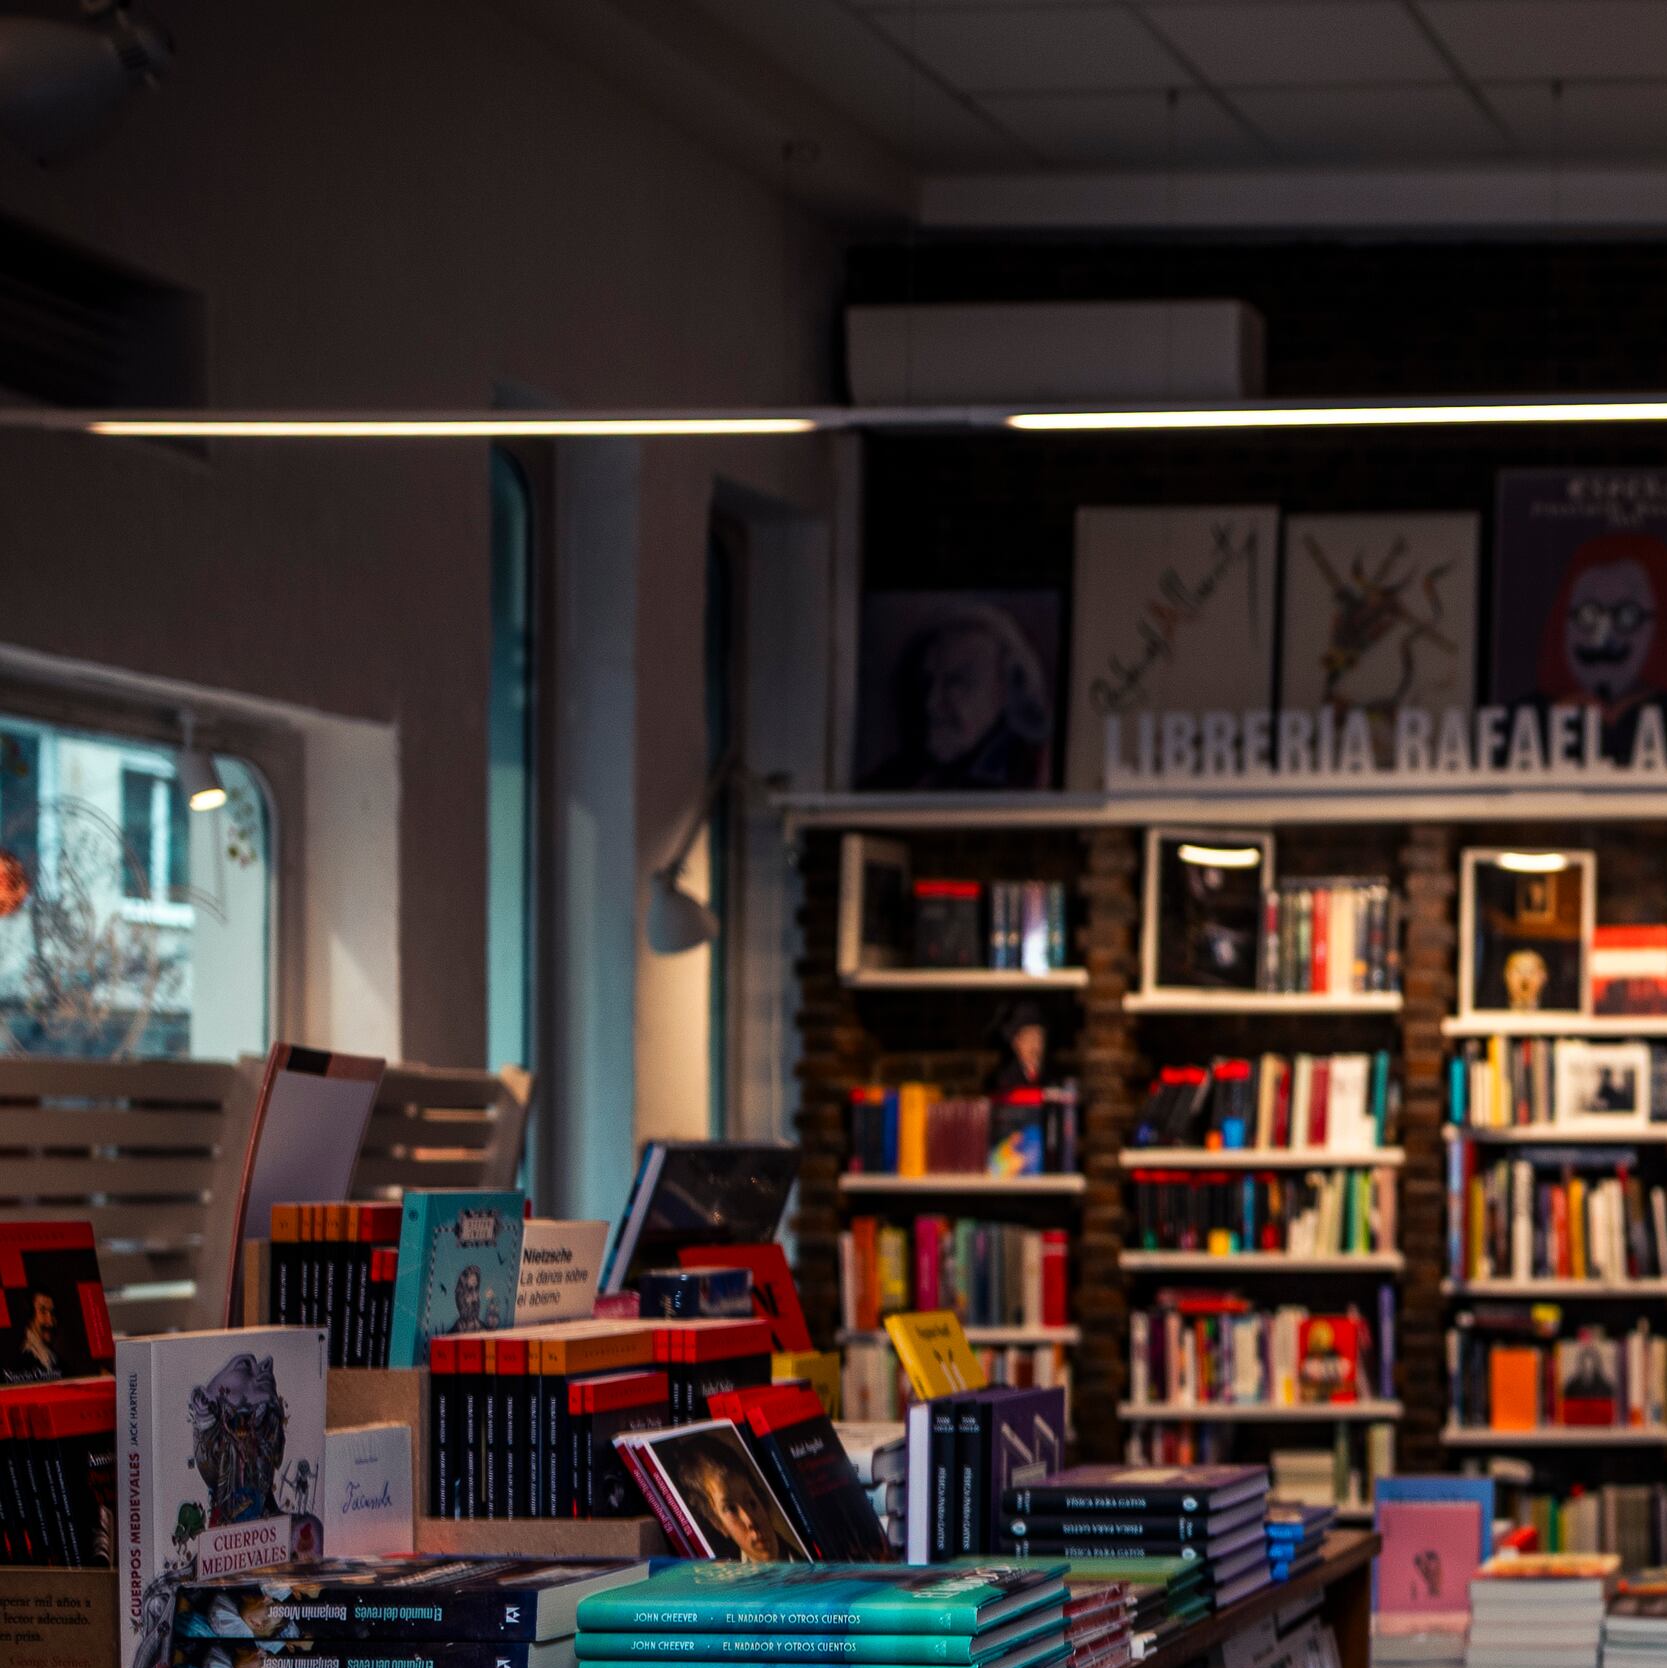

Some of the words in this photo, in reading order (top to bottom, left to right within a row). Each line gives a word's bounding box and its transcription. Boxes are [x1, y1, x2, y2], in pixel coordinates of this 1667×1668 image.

[1105, 706, 1378, 775] LIBRERÍA
[1400, 704, 1617, 773] RAFAEL
[523, 1250, 572, 1264] Nietzsche
[520, 1272, 532, 1285] La
[536, 1272, 562, 1283] danza
[565, 1269, 588, 1282] sobre
[517, 1294, 527, 1305] el
[529, 1292, 560, 1305] abismo
[130, 1374, 138, 1420] HARTNELL
[128, 1453, 140, 1544] MEDIEVALES
[214, 1527, 276, 1552] CUERPOS
[202, 1546, 287, 1576] MEDIEVALES
[130, 1549, 142, 1617] CUERPOS
[35, 1595, 52, 1608] mil
[56, 1597, 81, 1608] años
[86, 1600, 91, 1608] a
[4, 1612, 34, 1624] lector
[38, 1612, 90, 1625] adecuado.
[268, 1605, 301, 1619] Moser
[302, 1606, 347, 1621] Benjamin
[355, 1605, 382, 1620] revés
[383, 1606, 399, 1621] del
[399, 1606, 434, 1621] mundo
[435, 1607, 442, 1621] El
[633, 1613, 660, 1622] JOHN
[661, 1613, 698, 1622] CHEEVER
[726, 1613, 736, 1623] EL
[738, 1613, 779, 1624] NADADOR
[780, 1614, 786, 1623] Y
[788, 1614, 818, 1624] OTROS
[821, 1614, 861, 1624] CUENTOS
